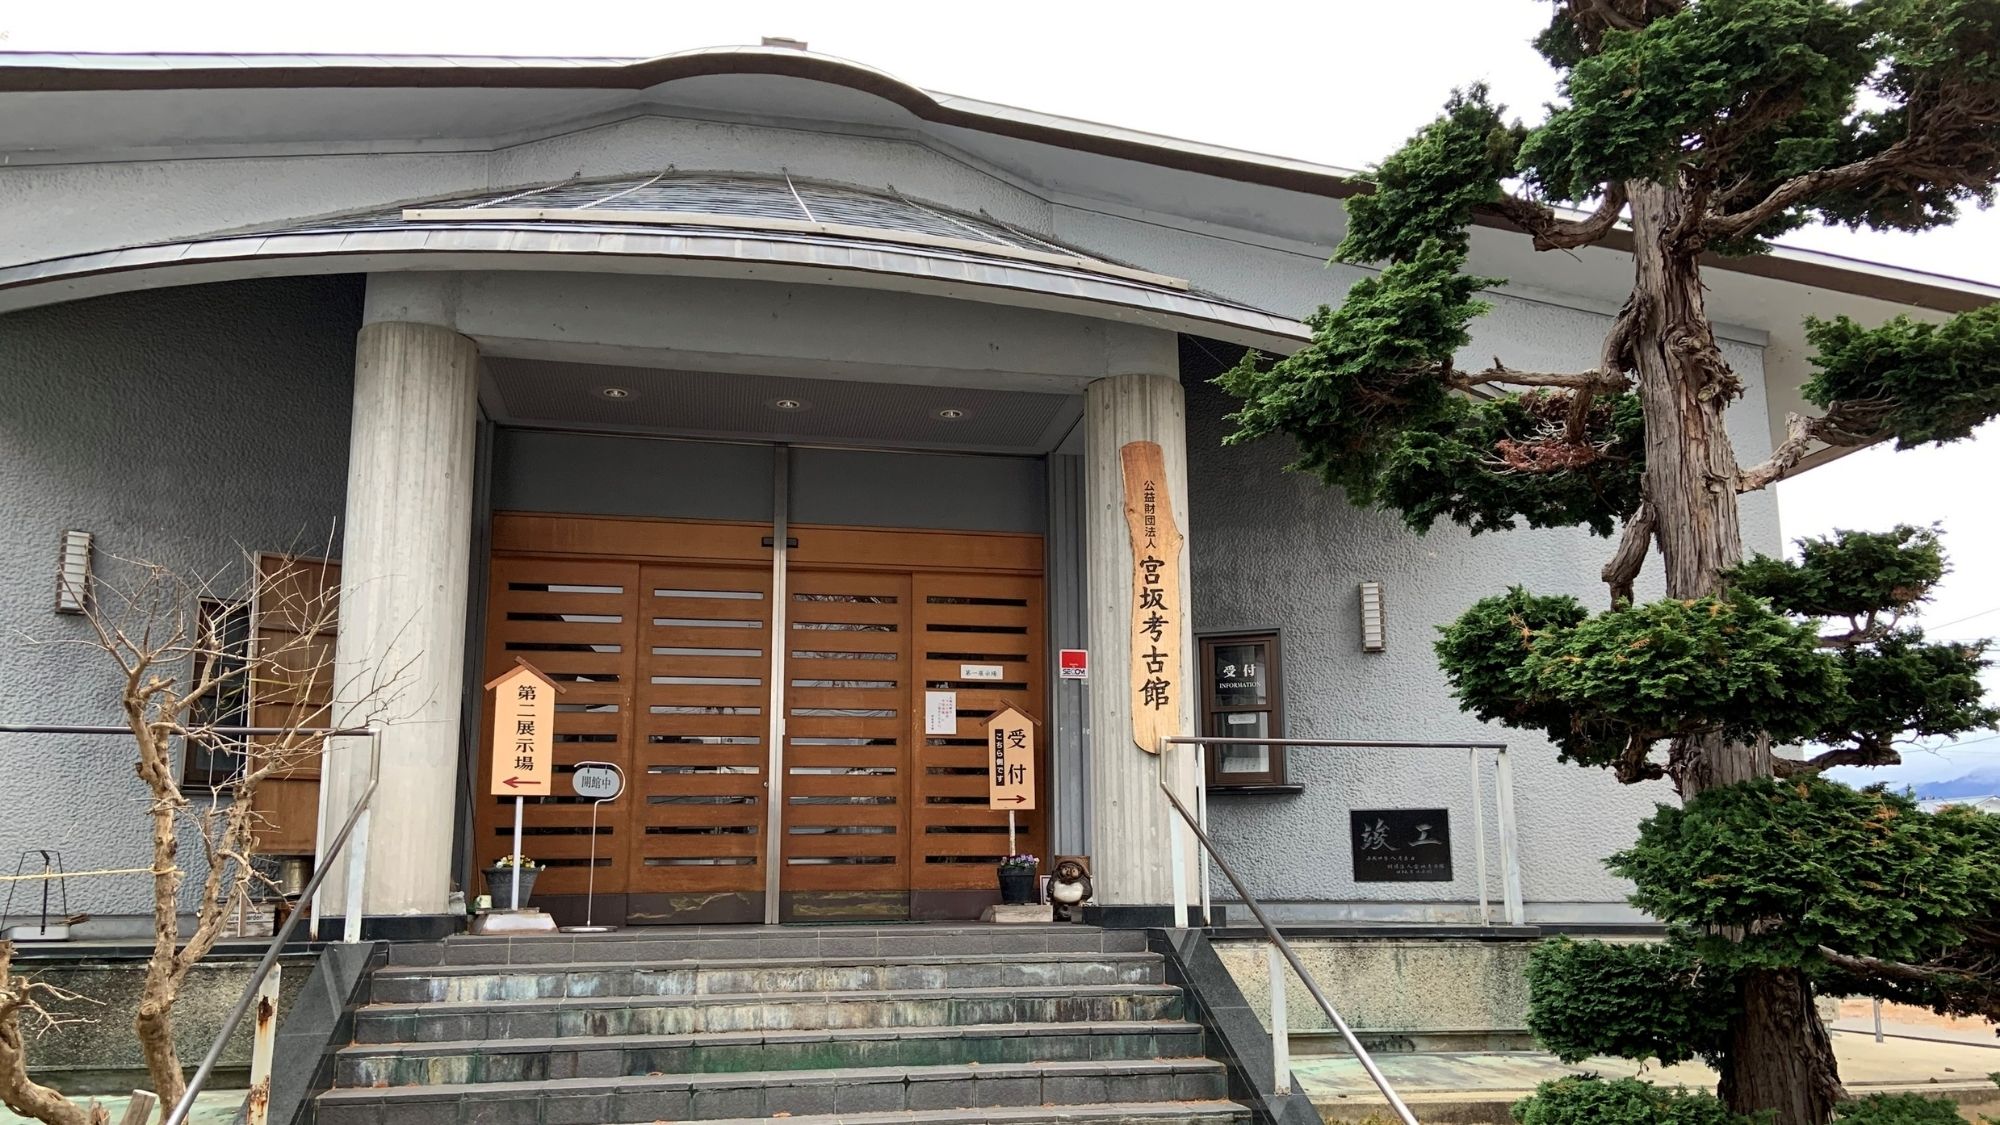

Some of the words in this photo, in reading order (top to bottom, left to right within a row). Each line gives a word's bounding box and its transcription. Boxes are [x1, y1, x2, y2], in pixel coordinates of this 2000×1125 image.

[1144, 480, 1157, 549] 公益財団法人
[1138, 556, 1171, 711] 宮坂考古館
[1219, 681, 1262, 689] INFORMATION
[1223, 664, 1256, 678] 受付
[514, 685, 537, 771] 第二展示場
[581, 775, 611, 790] 開館中
[1007, 729, 1026, 785] 受付
